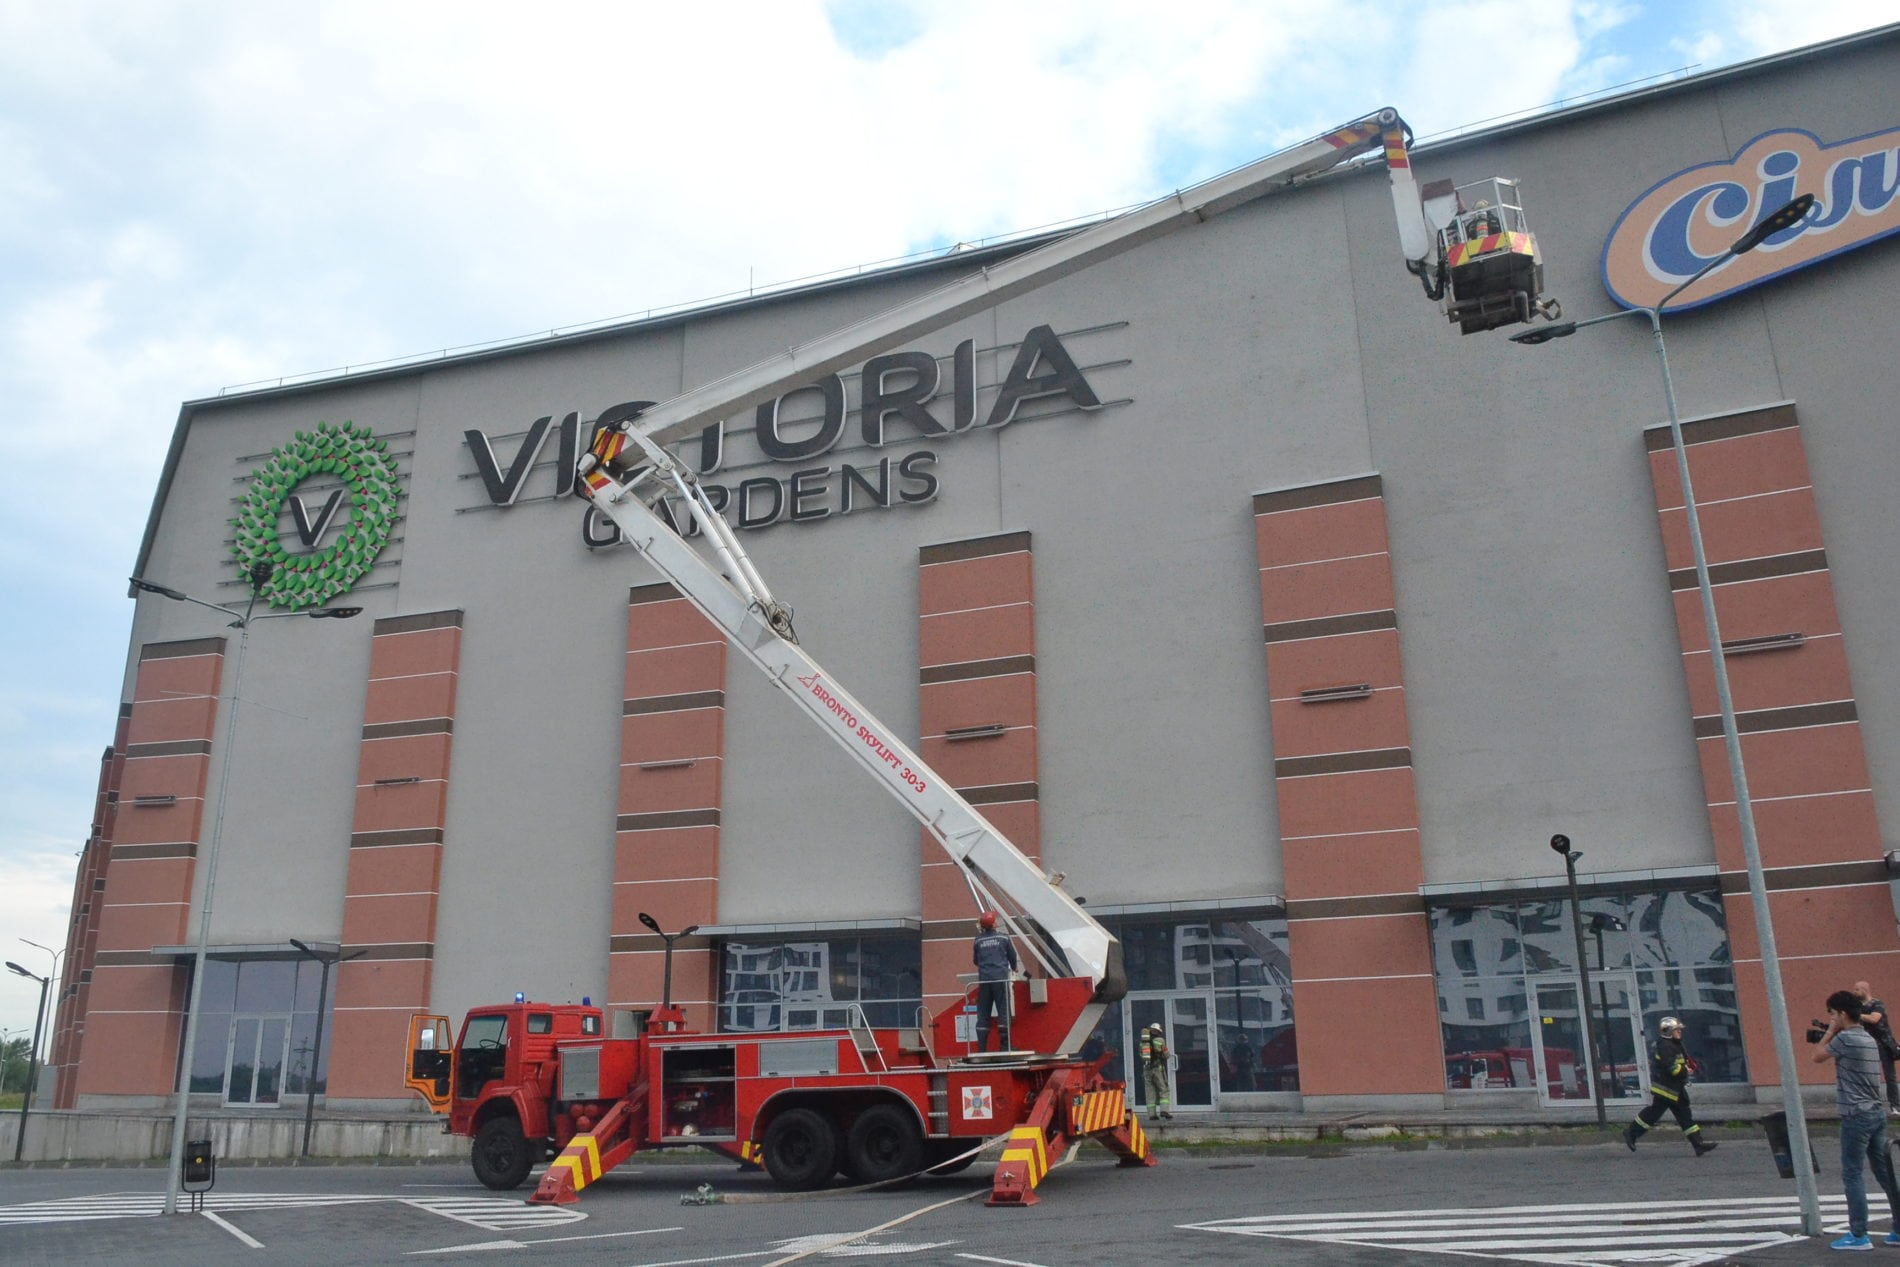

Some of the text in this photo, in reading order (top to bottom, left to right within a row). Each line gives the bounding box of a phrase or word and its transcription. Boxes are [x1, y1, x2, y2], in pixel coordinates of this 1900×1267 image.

[289, 489, 344, 547] V
[811, 683, 858, 729] BRONTO
[856, 725, 903, 770] SKYLIFT
